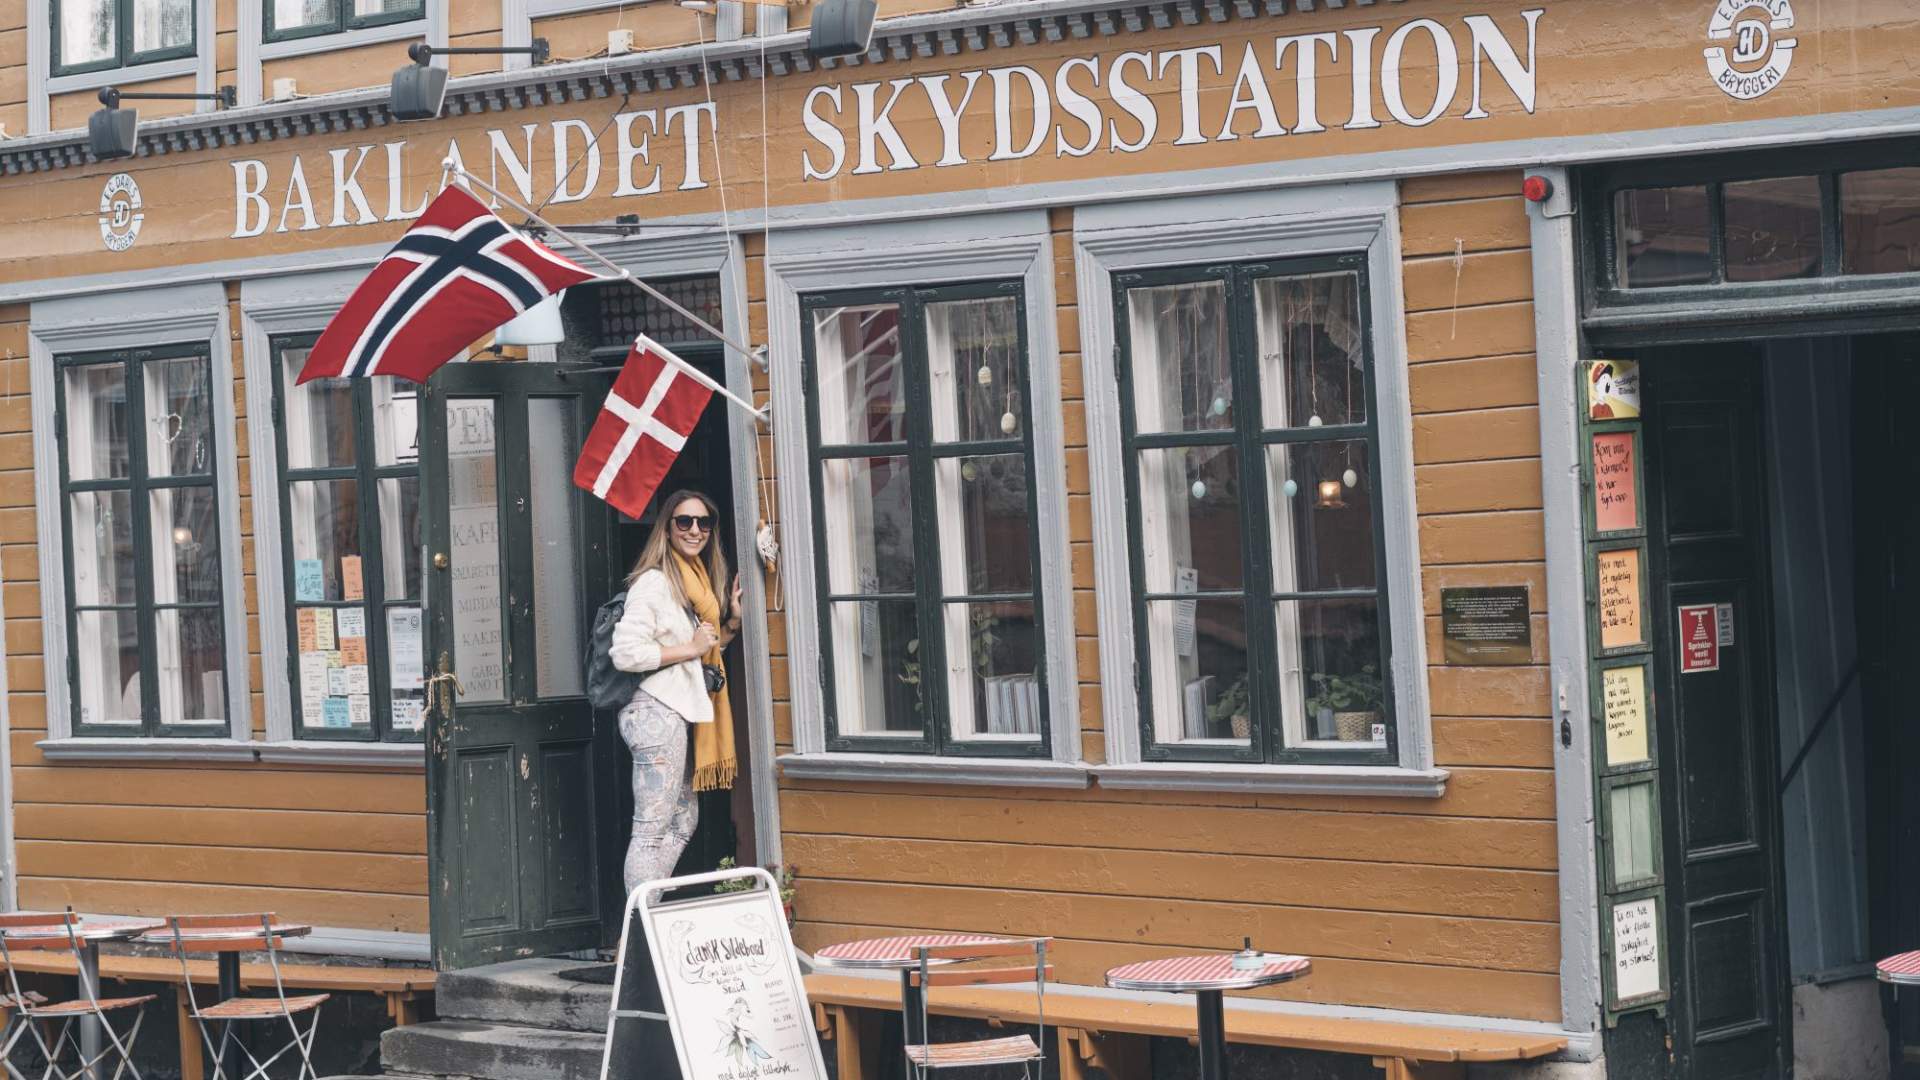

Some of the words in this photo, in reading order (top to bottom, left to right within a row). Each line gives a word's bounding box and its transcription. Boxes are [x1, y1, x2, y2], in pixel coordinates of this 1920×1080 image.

[802, 8, 1546, 182] SKYDSSTATION
[1718, 66, 1781, 95] BRYGGERI
[230, 100, 719, 240] BAKLANDET
